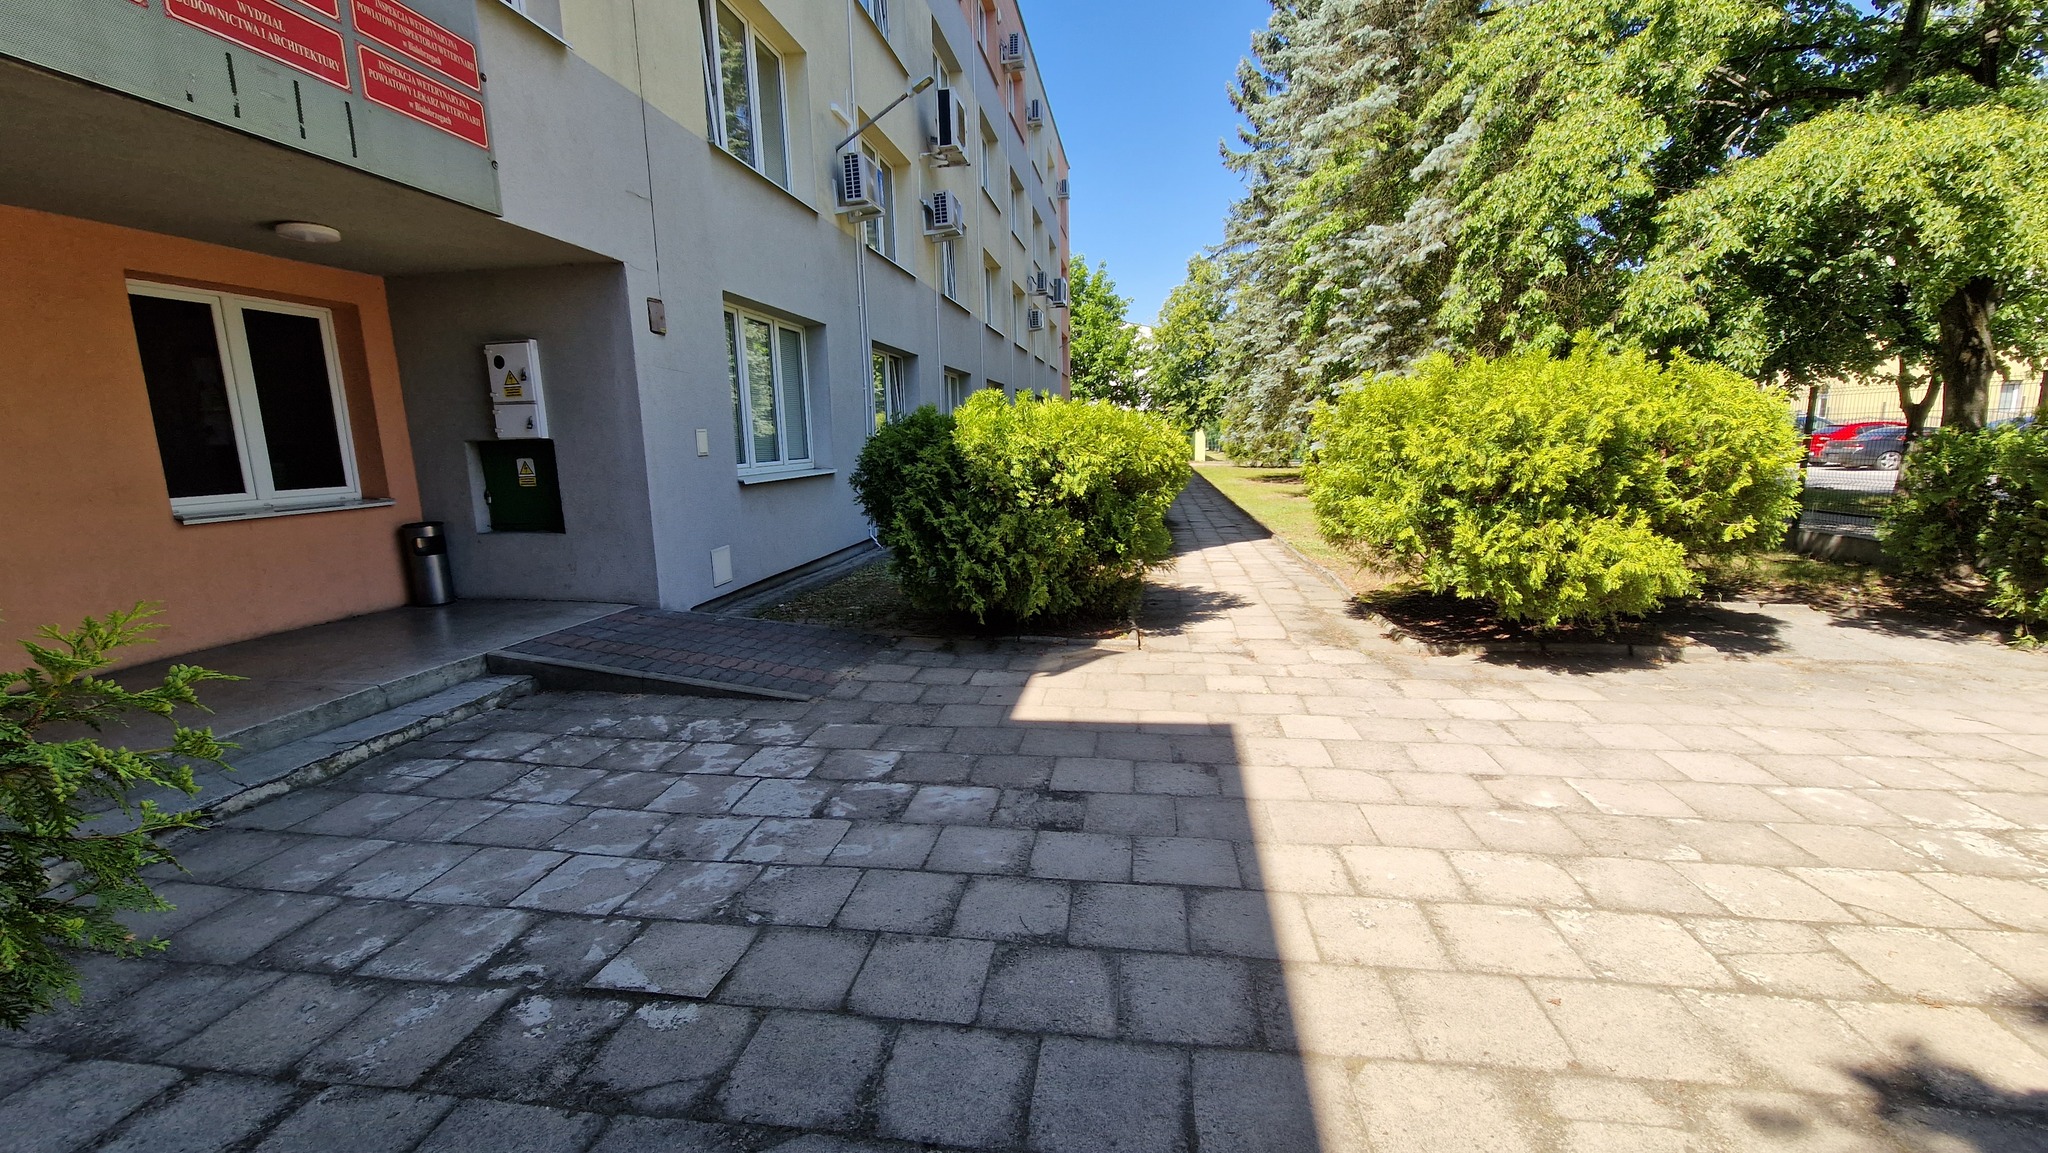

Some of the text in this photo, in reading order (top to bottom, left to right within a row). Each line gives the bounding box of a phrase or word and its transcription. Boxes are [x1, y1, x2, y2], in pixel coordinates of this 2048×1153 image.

[176, 0, 341, 72] UDOWNICTWA I ARCHITEKTURY
[236, 0, 286, 32] WYDZIAŁ
[356, 2, 398, 32] POWIATOWY
[375, 0, 458, 51] INSPEKCJA WETERYNARYJNA
[368, 68, 481, 127] POWIATOWY LEKARZ WETERYNARII
[378, 60, 470, 111] INSPEKCJA WETERYNARYJNA
